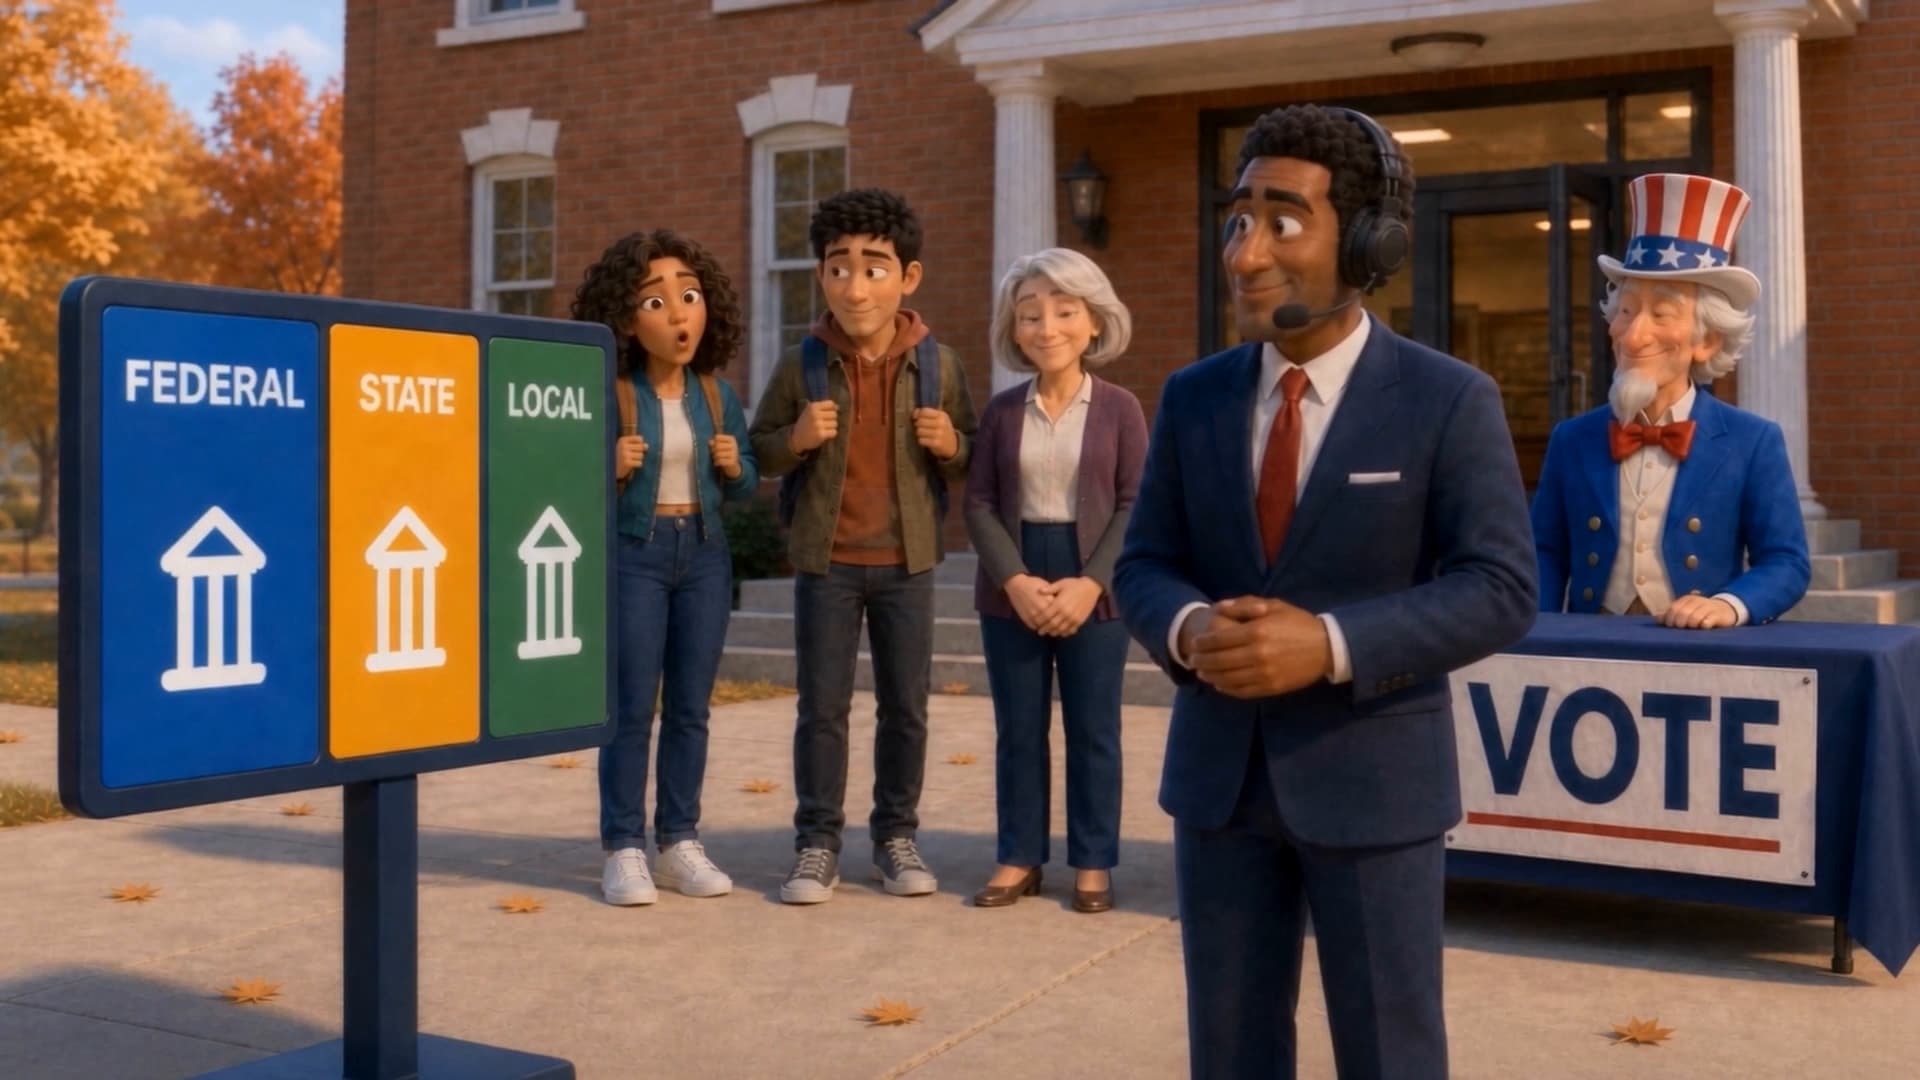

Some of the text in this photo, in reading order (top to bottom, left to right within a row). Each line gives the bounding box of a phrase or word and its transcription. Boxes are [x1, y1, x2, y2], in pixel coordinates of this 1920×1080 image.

[125, 358, 305, 409] FEDERAL
[359, 374, 455, 414] STATE
[507, 382, 592, 420] LOCAL
[1467, 681, 1781, 820] VOTE
